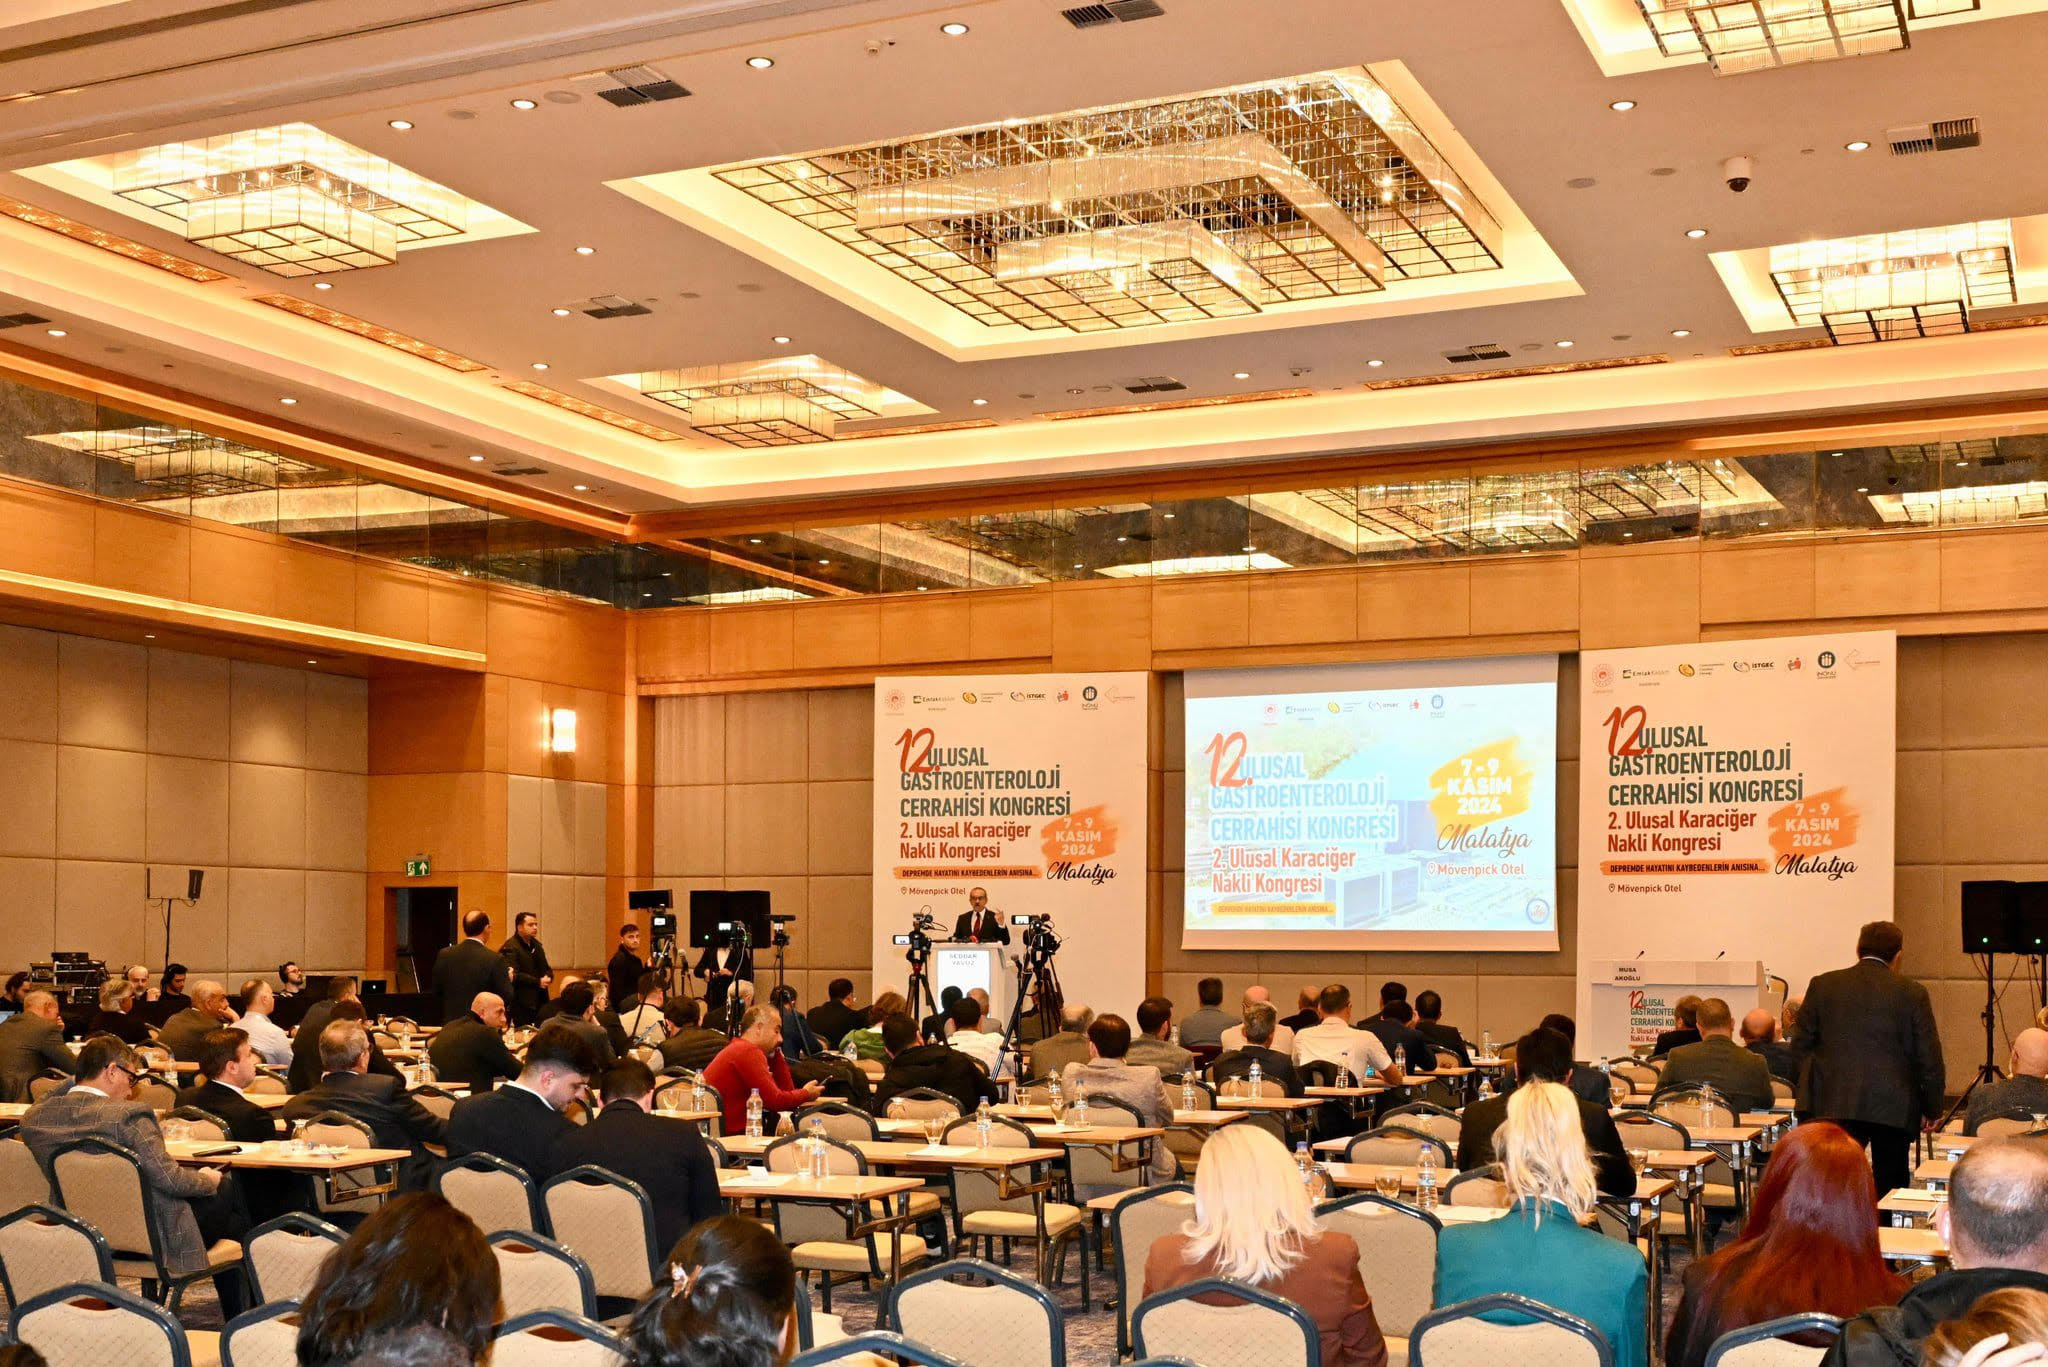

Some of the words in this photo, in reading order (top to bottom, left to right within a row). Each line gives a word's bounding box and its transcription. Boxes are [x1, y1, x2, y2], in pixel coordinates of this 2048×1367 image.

[1639, 725, 1708, 749] ULUSAL
[928, 747, 989, 767] ULUSAL
[1204, 731, 1254, 787] 12.
[1240, 755, 1306, 780] ULUSAL
[1608, 743, 1791, 777] GASTROENTEROLOJİ
[1461, 760, 1471, 776] 7
[1488, 759, 1499, 775] 9
[900, 765, 1060, 791] GASTROENTEROLOJİ
[1447, 778, 1512, 796] KASIM
[1211, 776, 1385, 809] GASTROENTEROLOJİ
[1608, 777, 1703, 806] CERRAHİSİ
[1709, 773, 1803, 803] KONGRESİ
[900, 792, 985, 817] CERRAHİSİ
[990, 791, 1070, 816] KONGRESİ
[1457, 798, 1502, 815] 2024
[1794, 804, 1804, 816] 7
[1820, 803, 1830, 815] 9
[1063, 818, 1072, 828] 7
[1085, 818, 1093, 828] 9
[1211, 811, 1301, 840] CERRAHİSİ
[1307, 808, 1396, 839] KONGRESİ
[1608, 812, 1621, 830] 2.
[1626, 810, 1674, 829] Ulusal
[1679, 809, 1757, 832] Karaciğer
[1785, 818, 1839, 832] KASIM
[900, 823, 912, 839] 2.
[916, 822, 960, 838] Ulusal
[964, 821, 1031, 841] Karaciğer
[1055, 830, 1101, 842] KASIM
[1436, 824, 1533, 858] Malatya
[1792, 834, 1832, 847] 2024
[900, 843, 935, 859] Nakli
[939, 842, 1000, 861] Kongresi
[1061, 844, 1095, 856] 2024
[1608, 833, 1647, 853] Nakli
[1652, 833, 1721, 856] Kongresi
[1213, 848, 1227, 869] 2.
[1230, 847, 1277, 868] Ulusal
[1281, 847, 1356, 872] Karaciğer
[1437, 863, 1497, 877] Mövenpick
[1502, 862, 1525, 876] Otel
[1610, 865, 1645, 873] DEPREMDE
[1646, 864, 1675, 872] HAYATINI
[1676, 862, 1729, 872] KAYBEDENLERİN
[1775, 853, 1857, 881] Malatya
[1047, 861, 1117, 885] Malatya
[909, 887, 948, 896] Mövenpick
[951, 887, 966, 895] Otel
[1212, 872, 1250, 893] Nakli
[1255, 872, 1322, 897] Kongresi
[1617, 883, 1662, 893] Mövenpick
[1664, 884, 1682, 892] Otel
[1631, 1017, 1664, 1026] CERRAHİSİ
